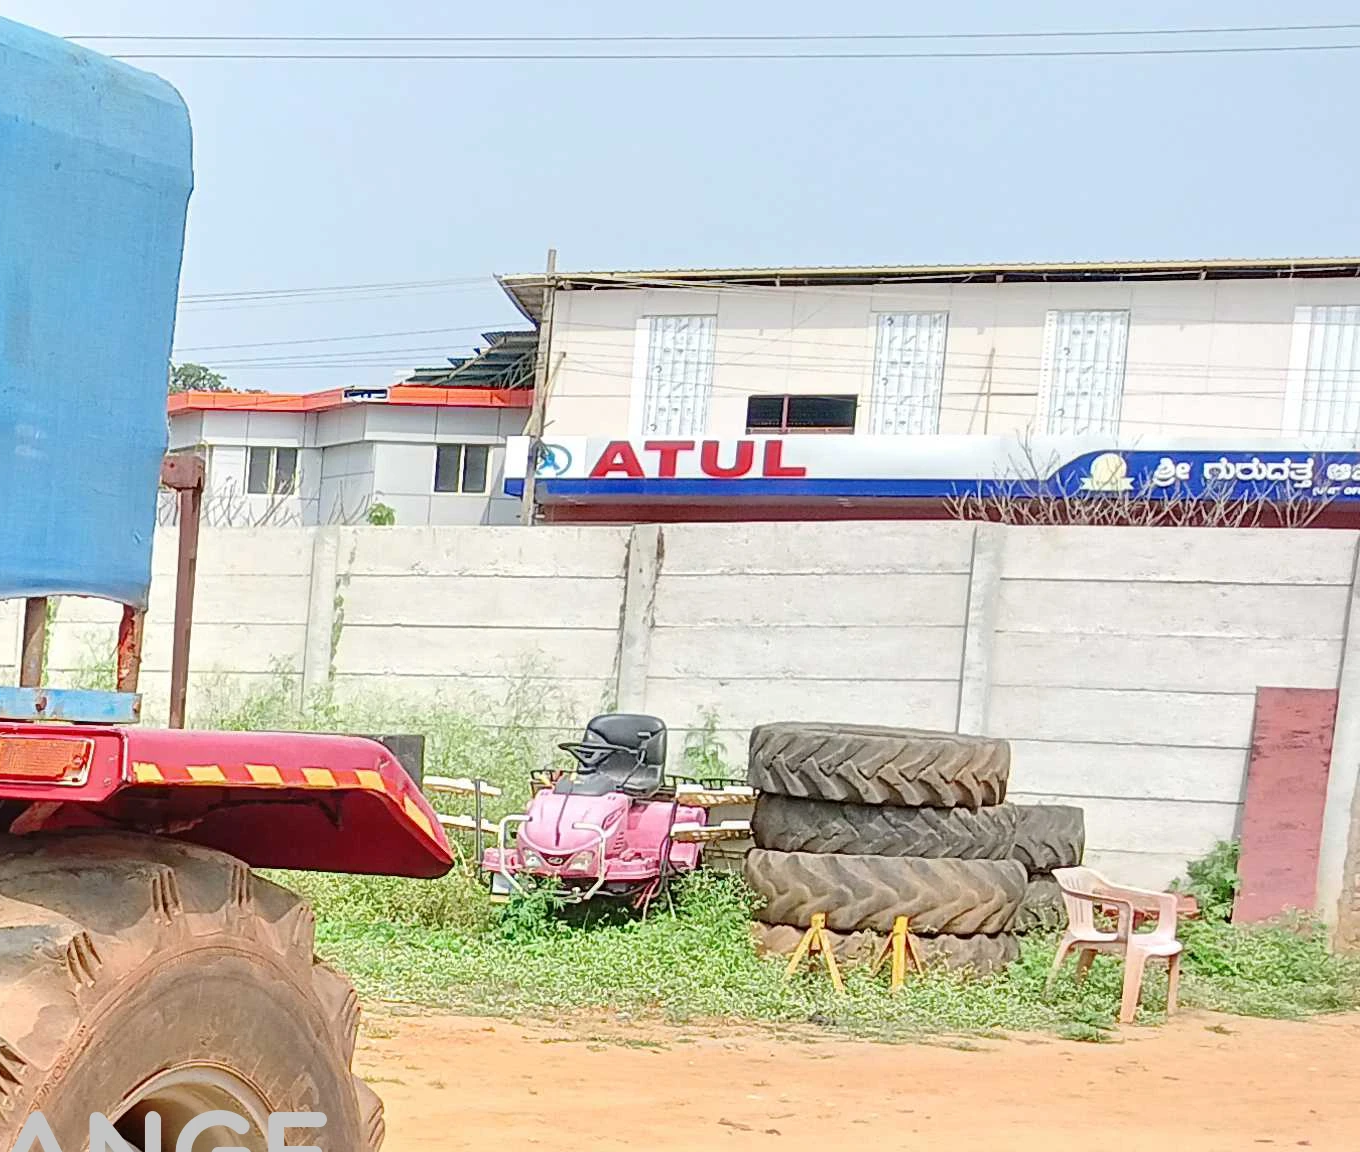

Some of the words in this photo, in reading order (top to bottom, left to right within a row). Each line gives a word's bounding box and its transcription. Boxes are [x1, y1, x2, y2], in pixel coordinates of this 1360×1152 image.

[590, 439, 806, 480] ATUL
[1153, 457, 1192, 487] ಶ್ರೀ
[1203, 456, 1314, 488] ಗುರುದತ್ತ
